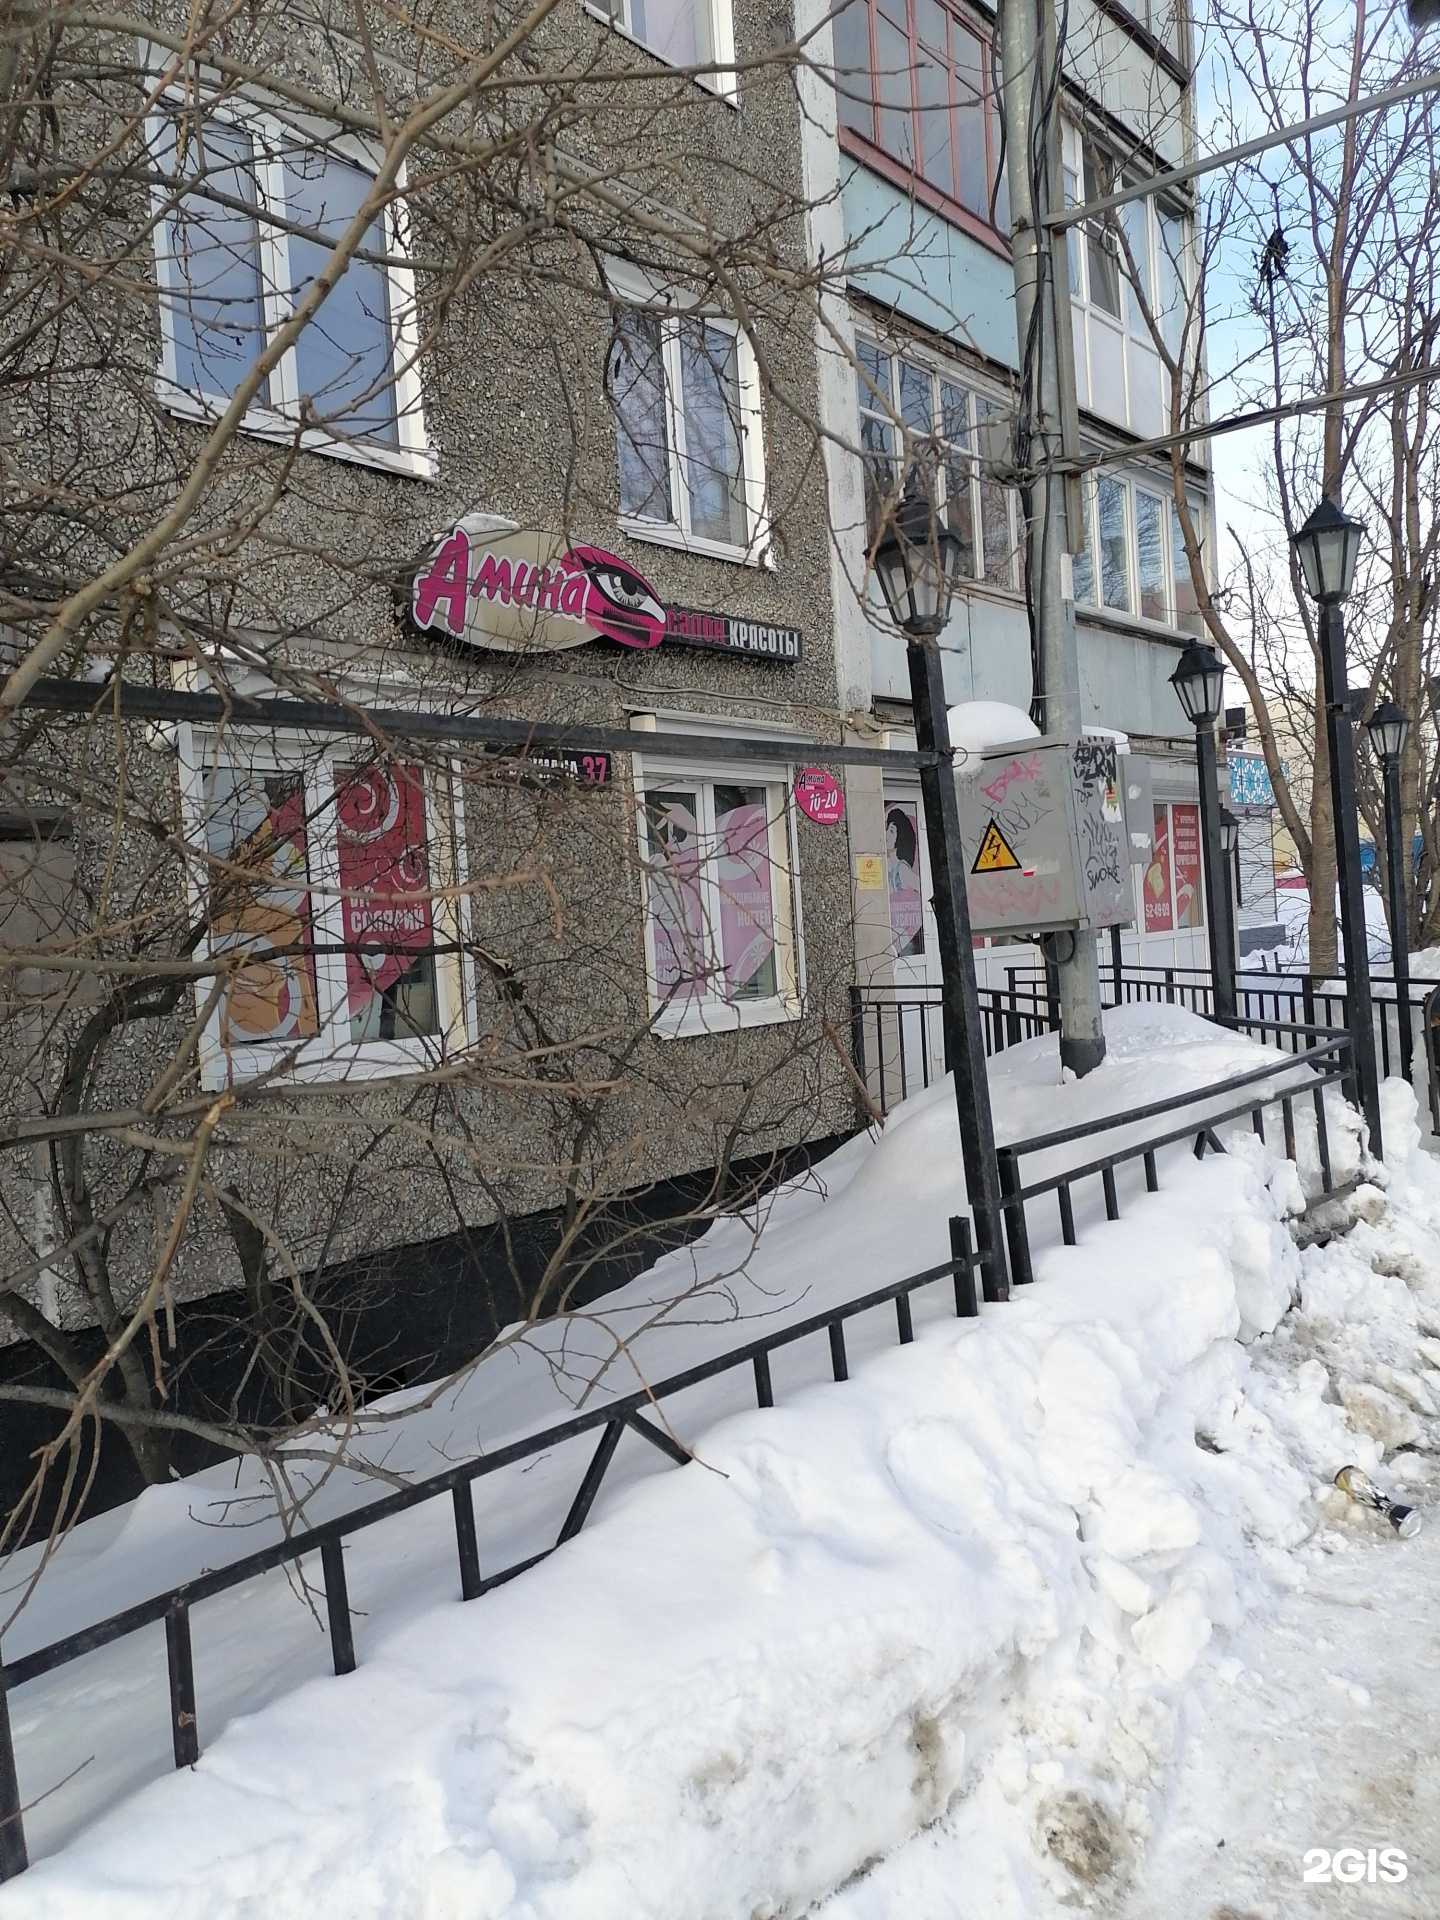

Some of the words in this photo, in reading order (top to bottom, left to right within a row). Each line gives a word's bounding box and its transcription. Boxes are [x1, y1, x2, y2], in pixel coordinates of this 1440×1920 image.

[412, 525, 592, 637] Амина
[729, 619, 799, 657] КРАСОТЫ
[583, 755, 607, 784] 37
